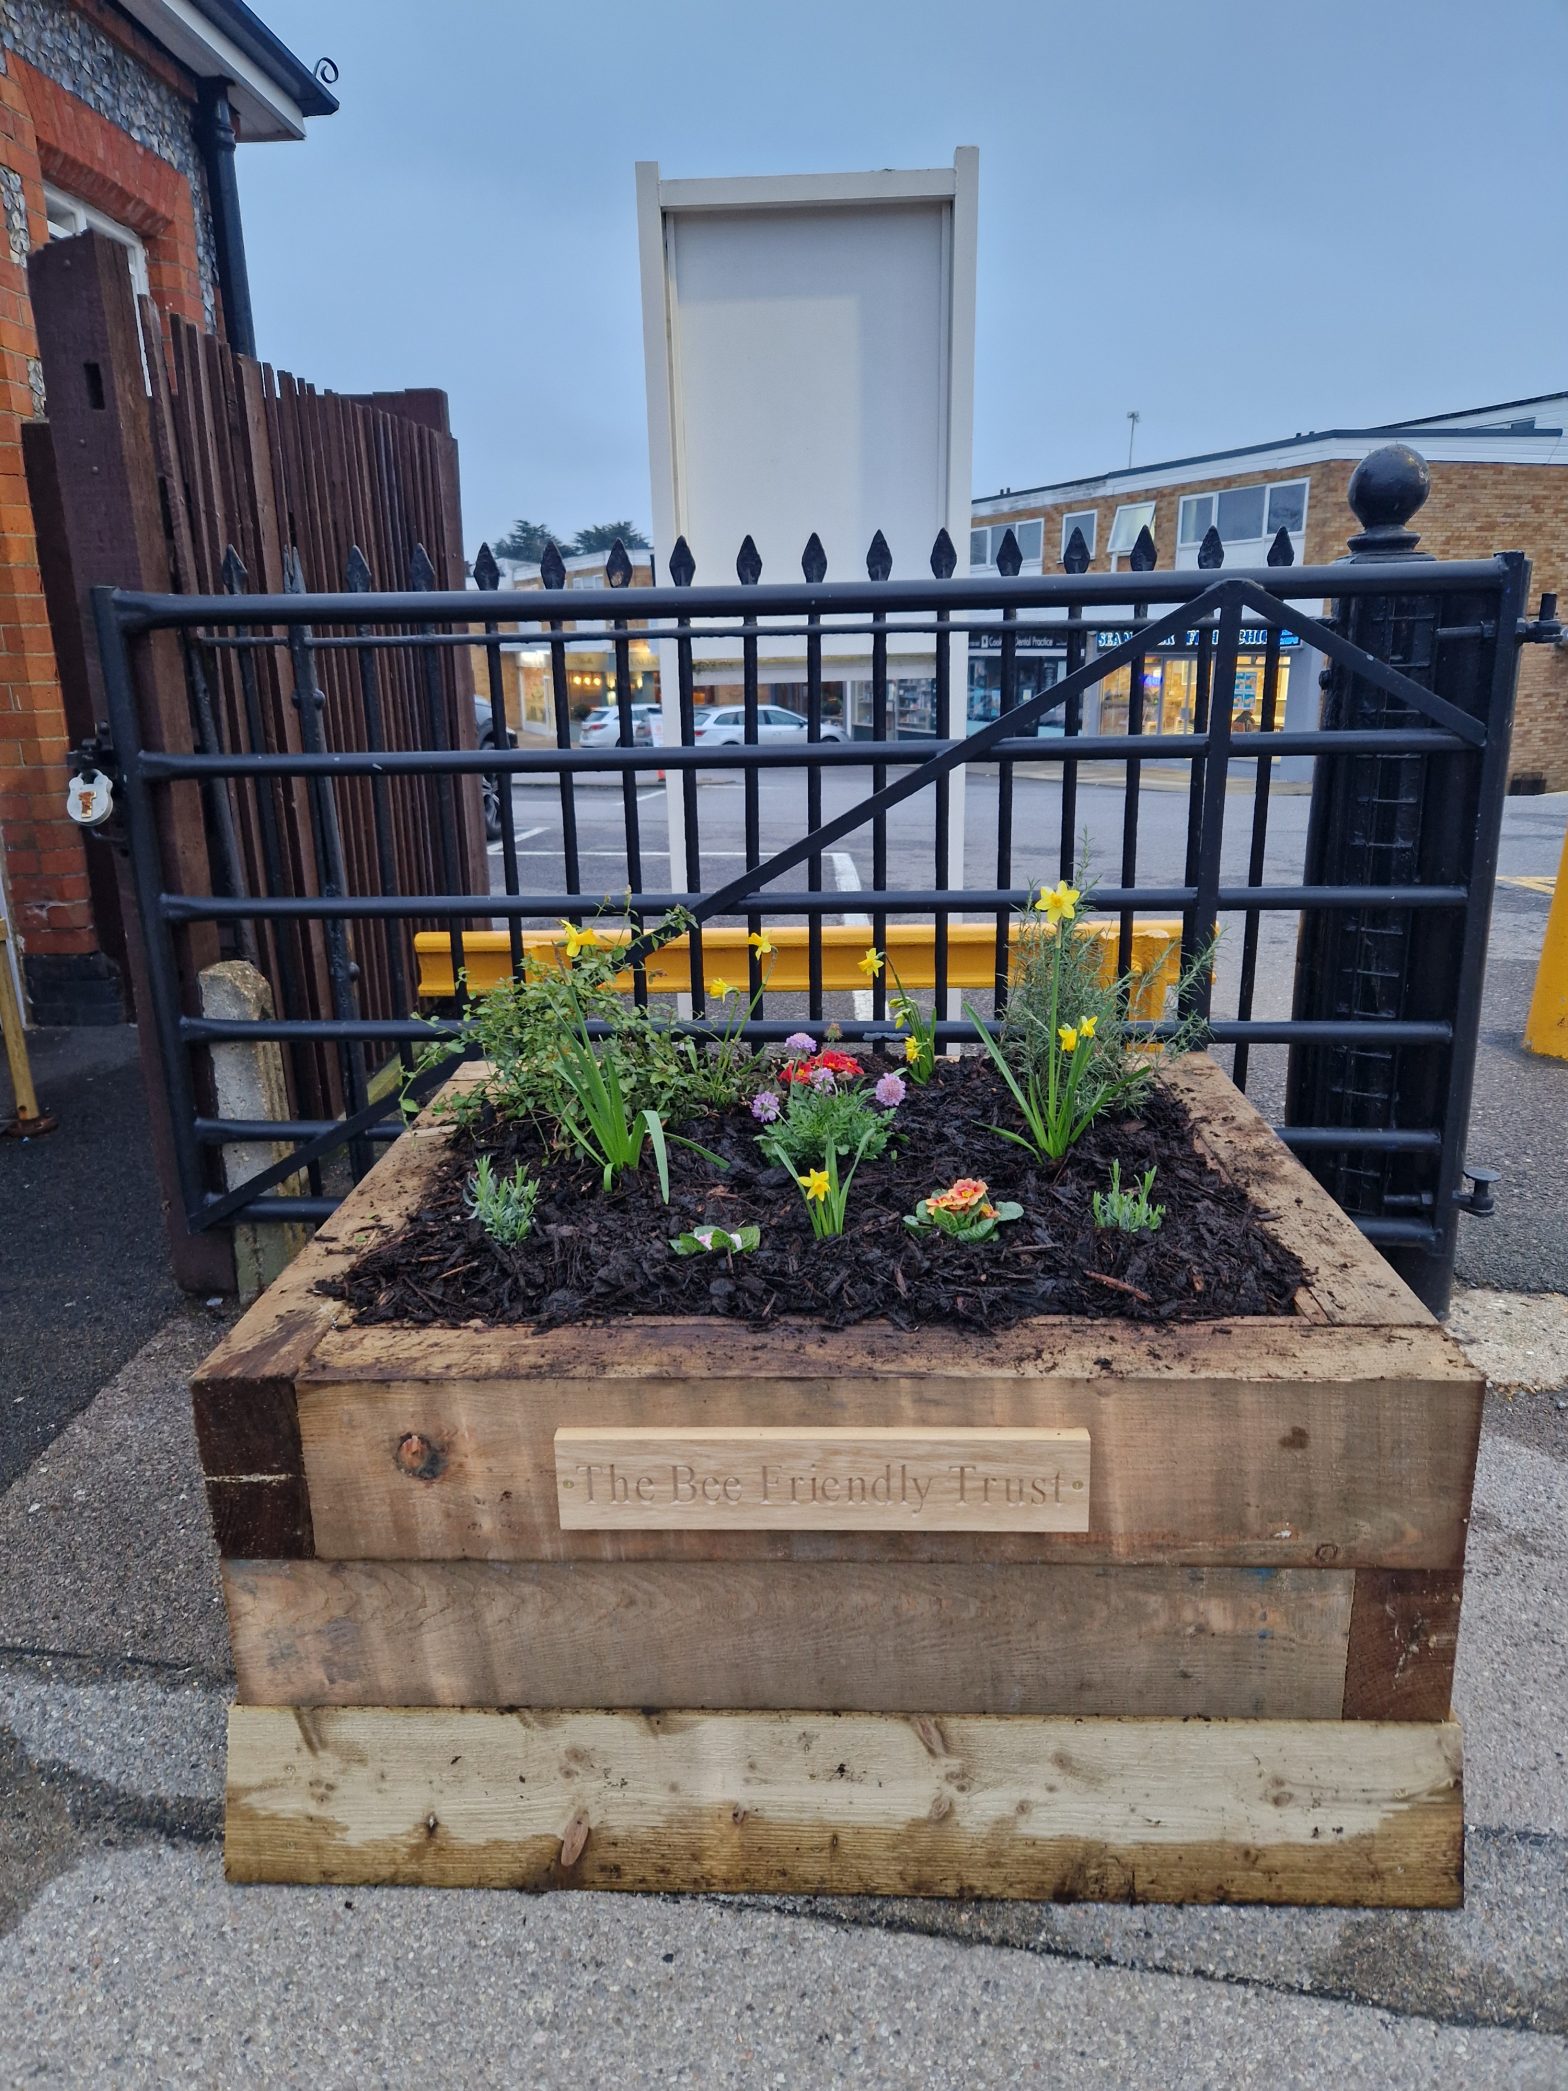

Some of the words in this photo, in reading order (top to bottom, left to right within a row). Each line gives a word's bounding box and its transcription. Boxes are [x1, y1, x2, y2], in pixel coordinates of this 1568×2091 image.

[1032, 636, 1053, 647] Practice
[576, 1464, 655, 1505] The
[670, 1464, 743, 1505] Bee
[761, 1462, 933, 1516] Friendly
[948, 1465, 1066, 1507] Trust
